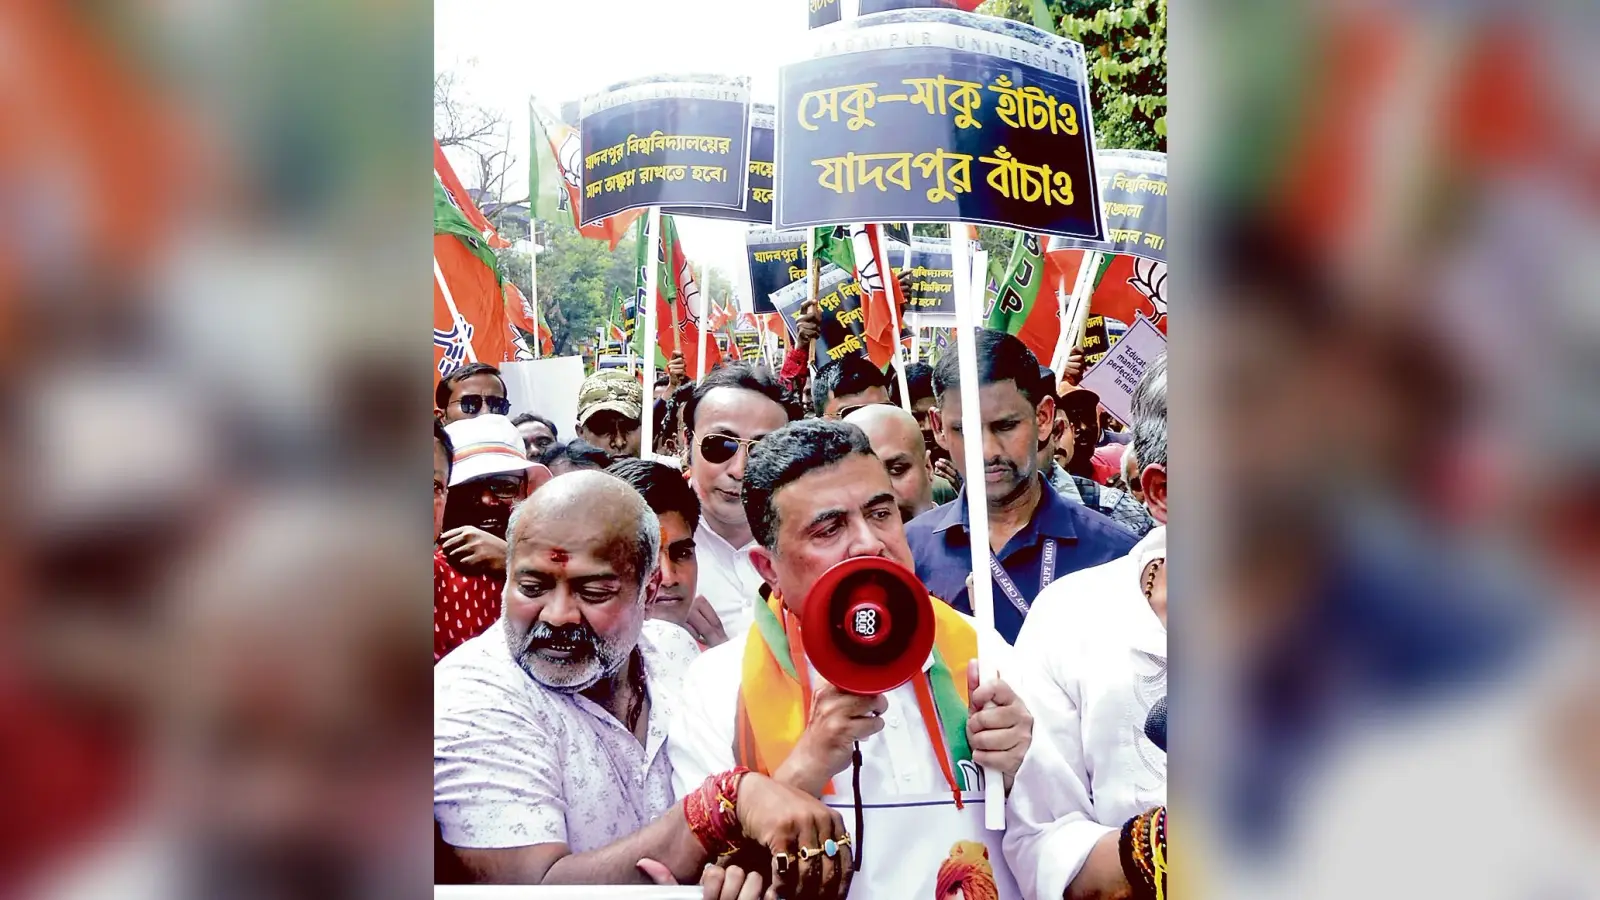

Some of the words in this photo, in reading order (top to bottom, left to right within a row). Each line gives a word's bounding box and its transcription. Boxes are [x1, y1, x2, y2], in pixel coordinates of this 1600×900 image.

[955, 35, 1071, 77] UNIVERSITY
[988, 74, 1079, 136] হাঁটাও
[584, 143, 625, 170] যাদবপুর
[626, 130, 731, 156] বিশ্ববিদ্যালয়ের
[586, 180, 602, 199] মান
[639, 165, 688, 185] রাখতে
[811, 148, 974, 203] যাদবপুর
[978, 145, 1075, 206] বাঁচাও
[1112, 172, 1167, 196] বিশ্ববিদ্যা
[754, 248, 798, 263] যাদবপুর
[1106, 359, 1138, 386] perfection
[1000, 577, 1018, 598] CRPF
